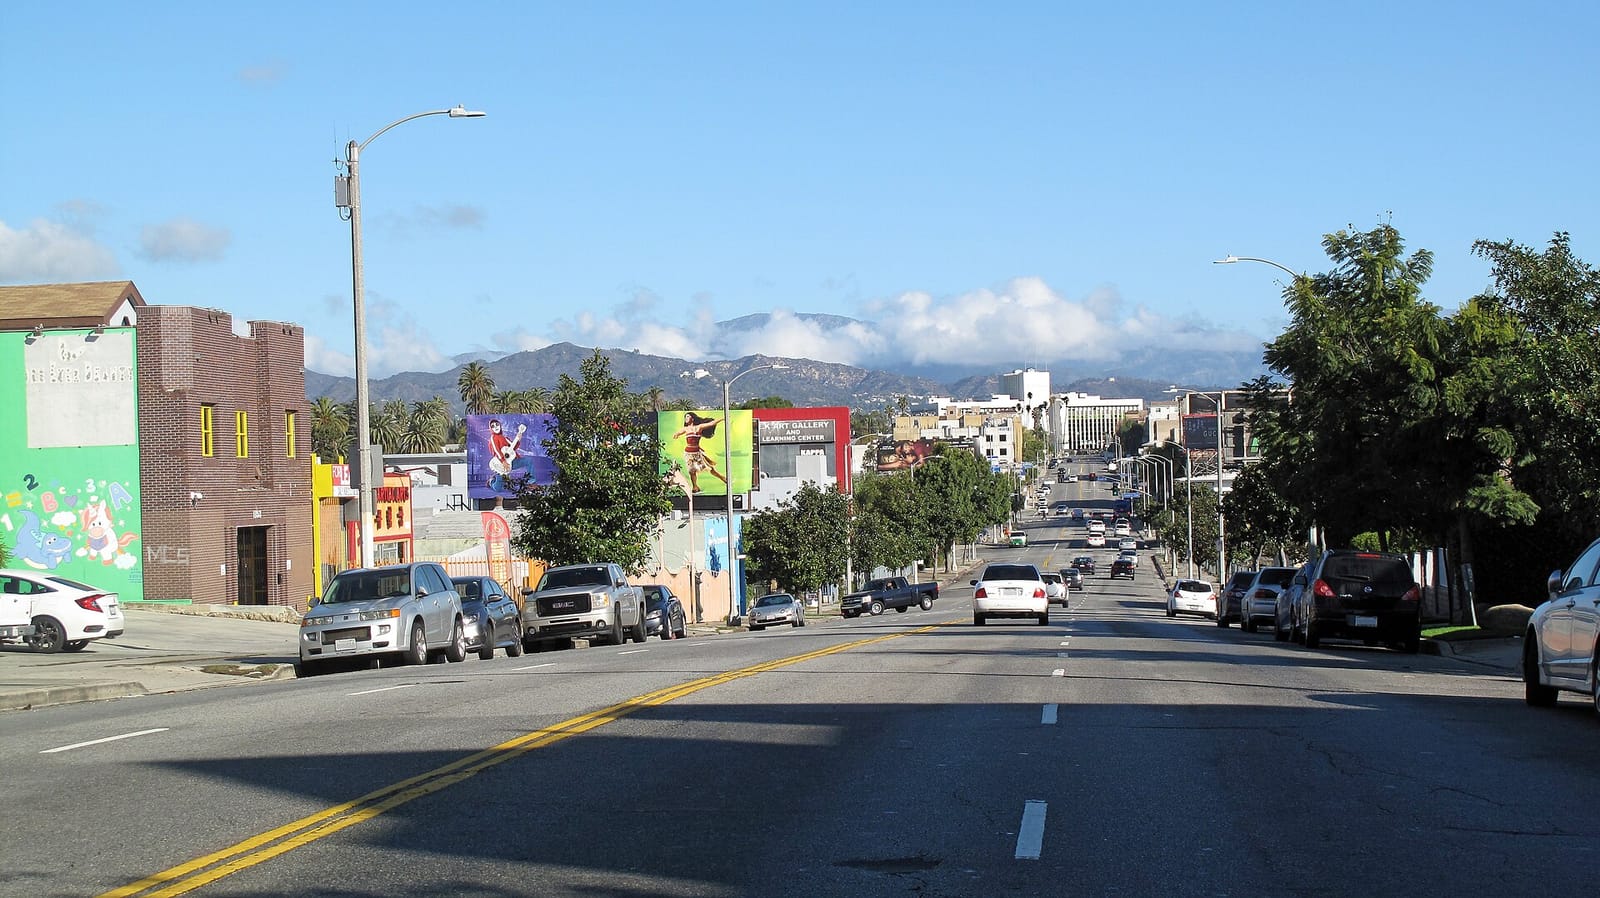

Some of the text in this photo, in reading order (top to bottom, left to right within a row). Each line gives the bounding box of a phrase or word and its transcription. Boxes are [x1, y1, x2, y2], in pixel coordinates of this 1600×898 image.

[791, 421, 829, 429] GALLERY
[23, 473, 39, 491] 2
[85, 478, 97, 493] 3
[41, 491, 58, 513] B
[109, 481, 133, 511] A
